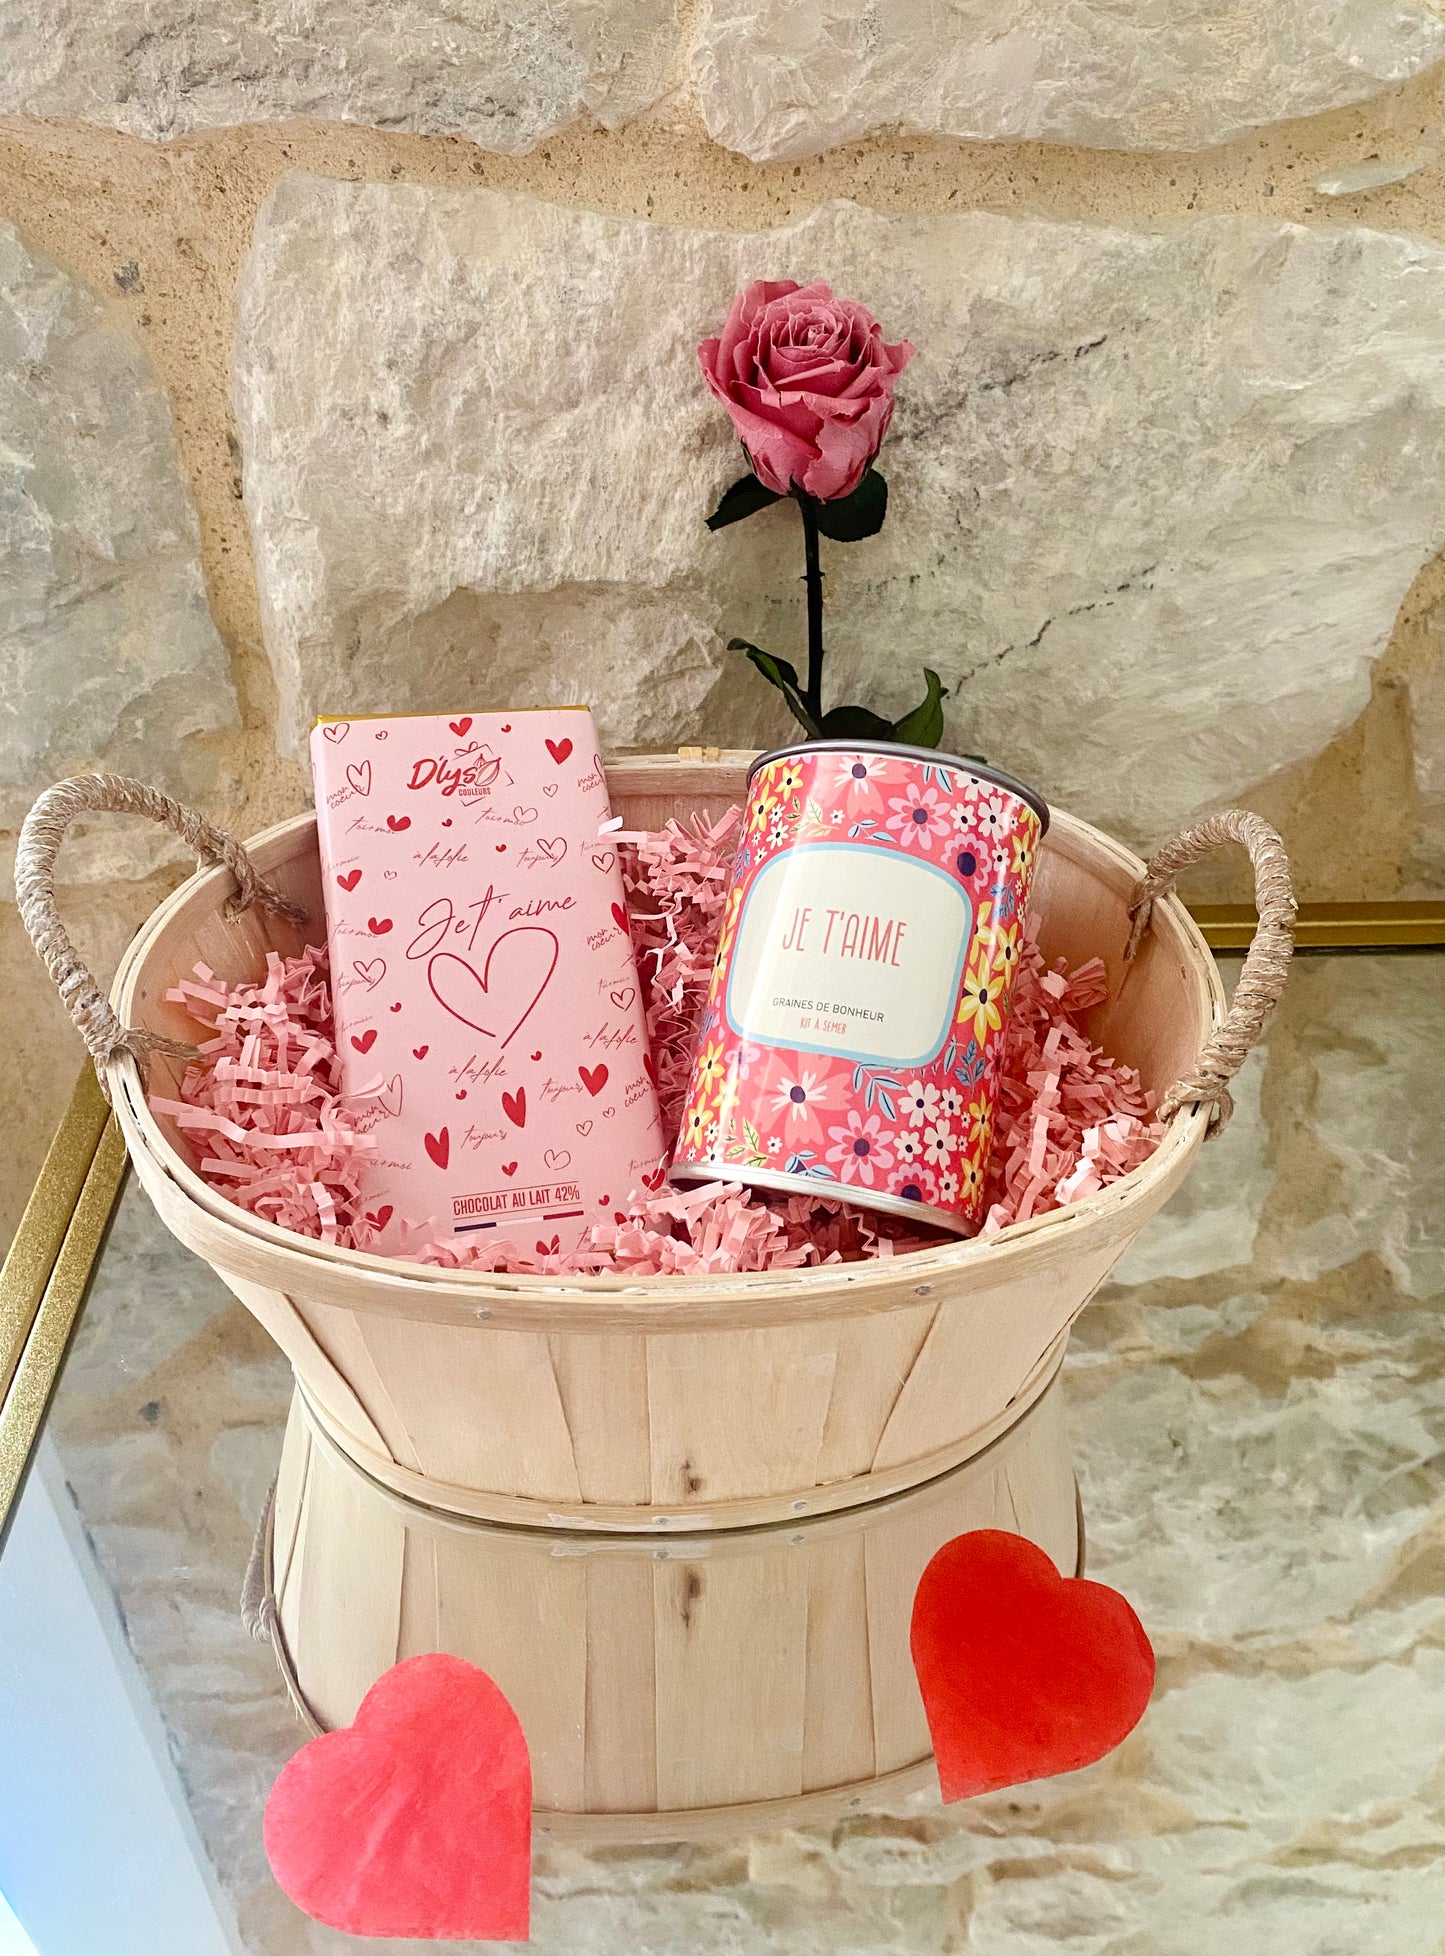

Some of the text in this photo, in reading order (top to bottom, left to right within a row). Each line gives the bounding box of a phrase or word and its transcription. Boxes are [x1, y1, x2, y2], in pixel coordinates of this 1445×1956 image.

[458, 787, 491, 797] COULEURS
[782, 907, 907, 967] JE T'AIME
[772, 997, 885, 1022] GRAINES DE BONHEUR
[800, 1016, 847, 1035] KIT À SEMER
[453, 1184, 580, 1216] CHOCOLAT AU LAIT 42%
